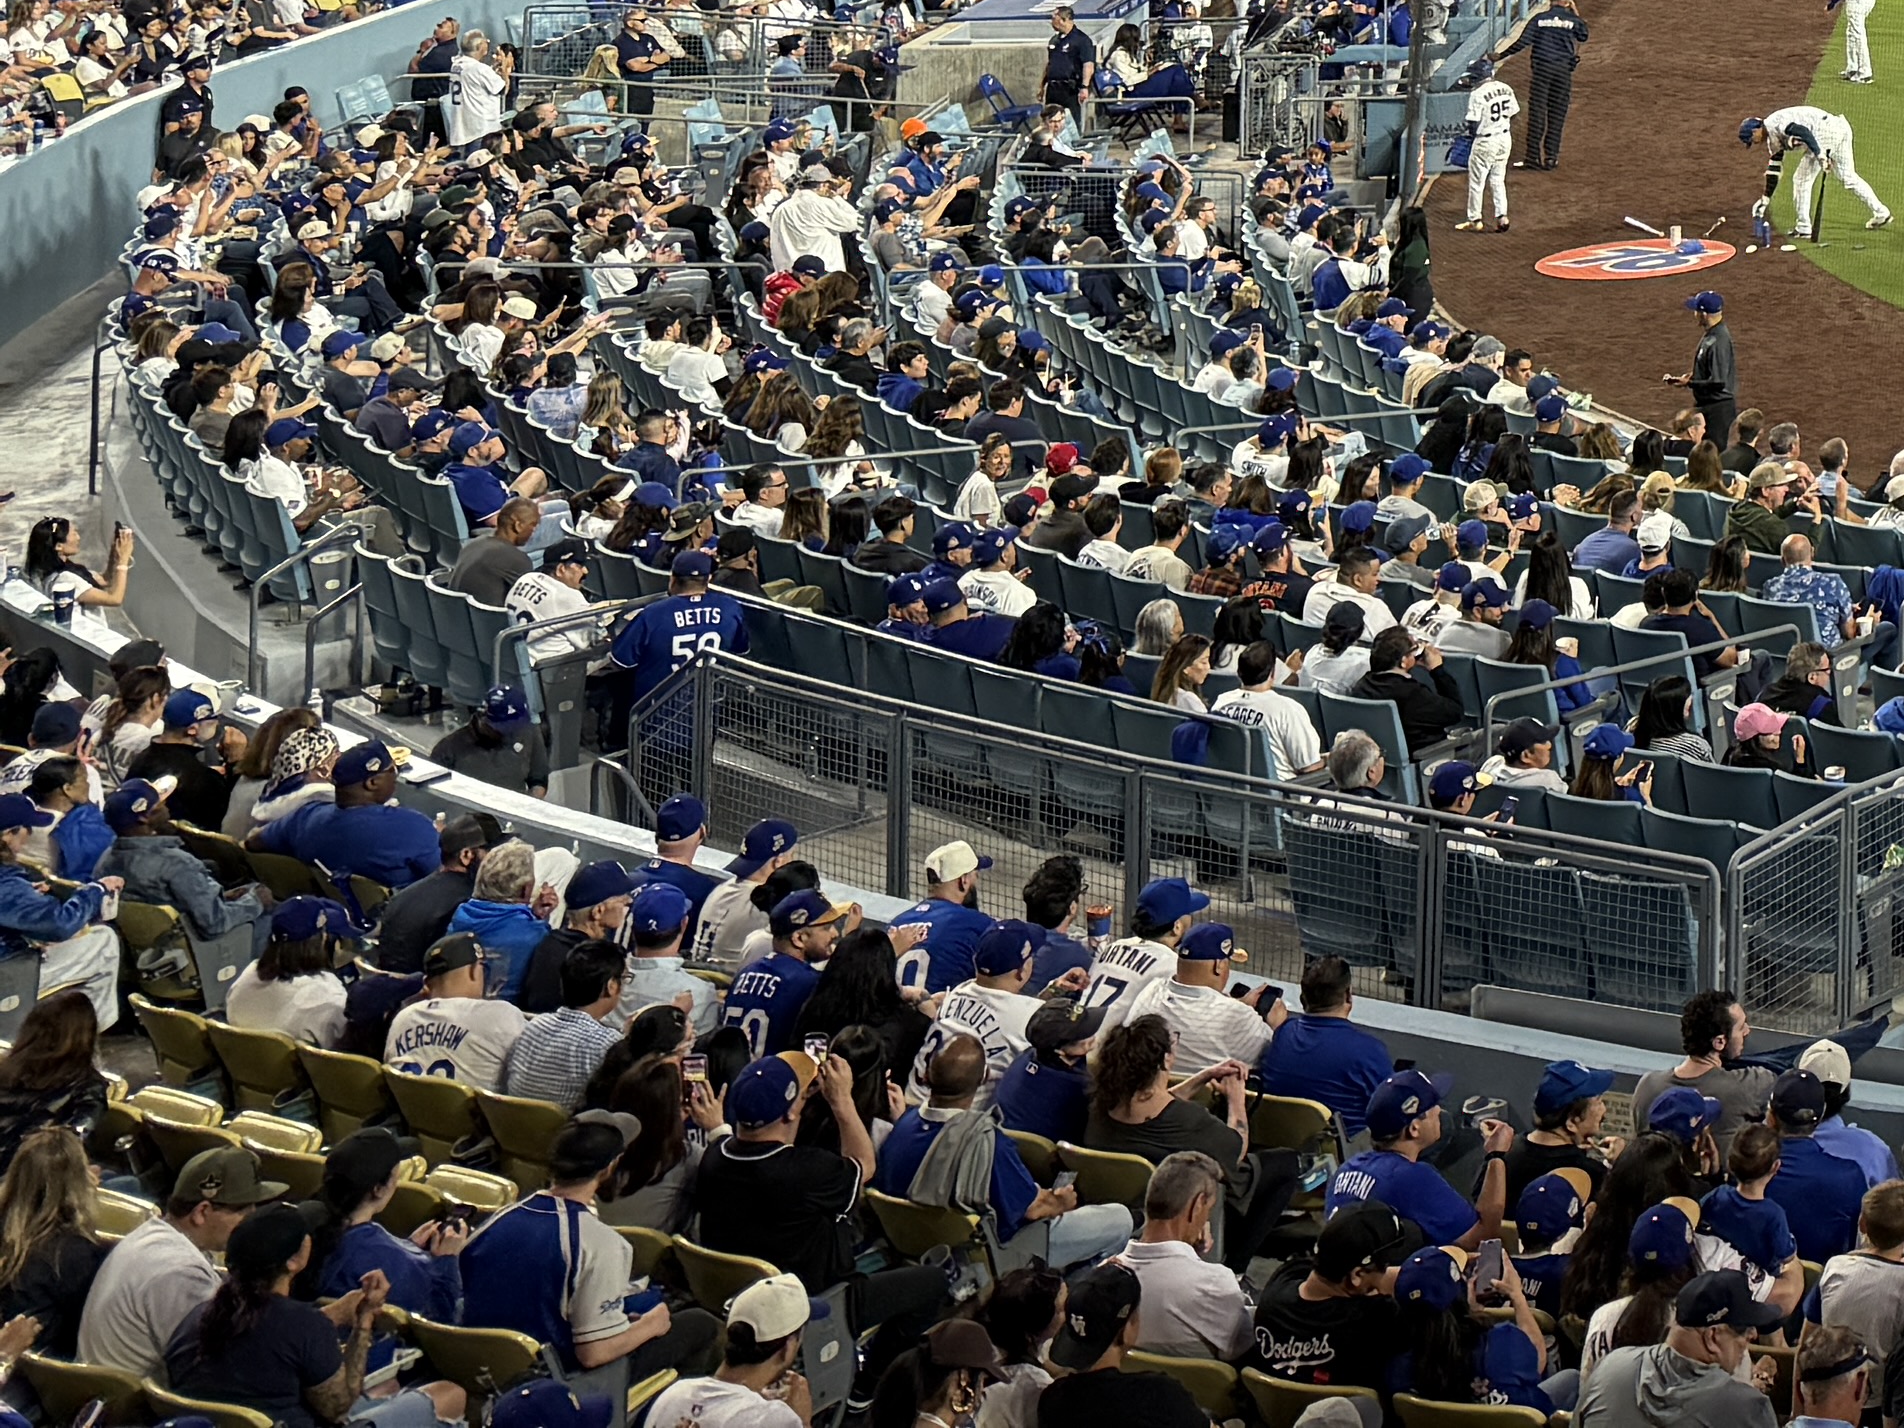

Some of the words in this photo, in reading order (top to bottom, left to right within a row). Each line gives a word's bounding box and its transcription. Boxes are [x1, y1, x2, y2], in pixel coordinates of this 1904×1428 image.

[1490, 99, 1511, 123] 95
[514, 581, 547, 605] BETTS
[674, 607, 722, 628] BETTS
[1087, 974, 1130, 1008] 17
[395, 1022, 469, 1057] KERSHAW
[945, 998, 1009, 1059] ENZUELA
[1333, 1172, 1376, 1201] OHTANI
[1255, 1326, 1336, 1376] Dodgers
